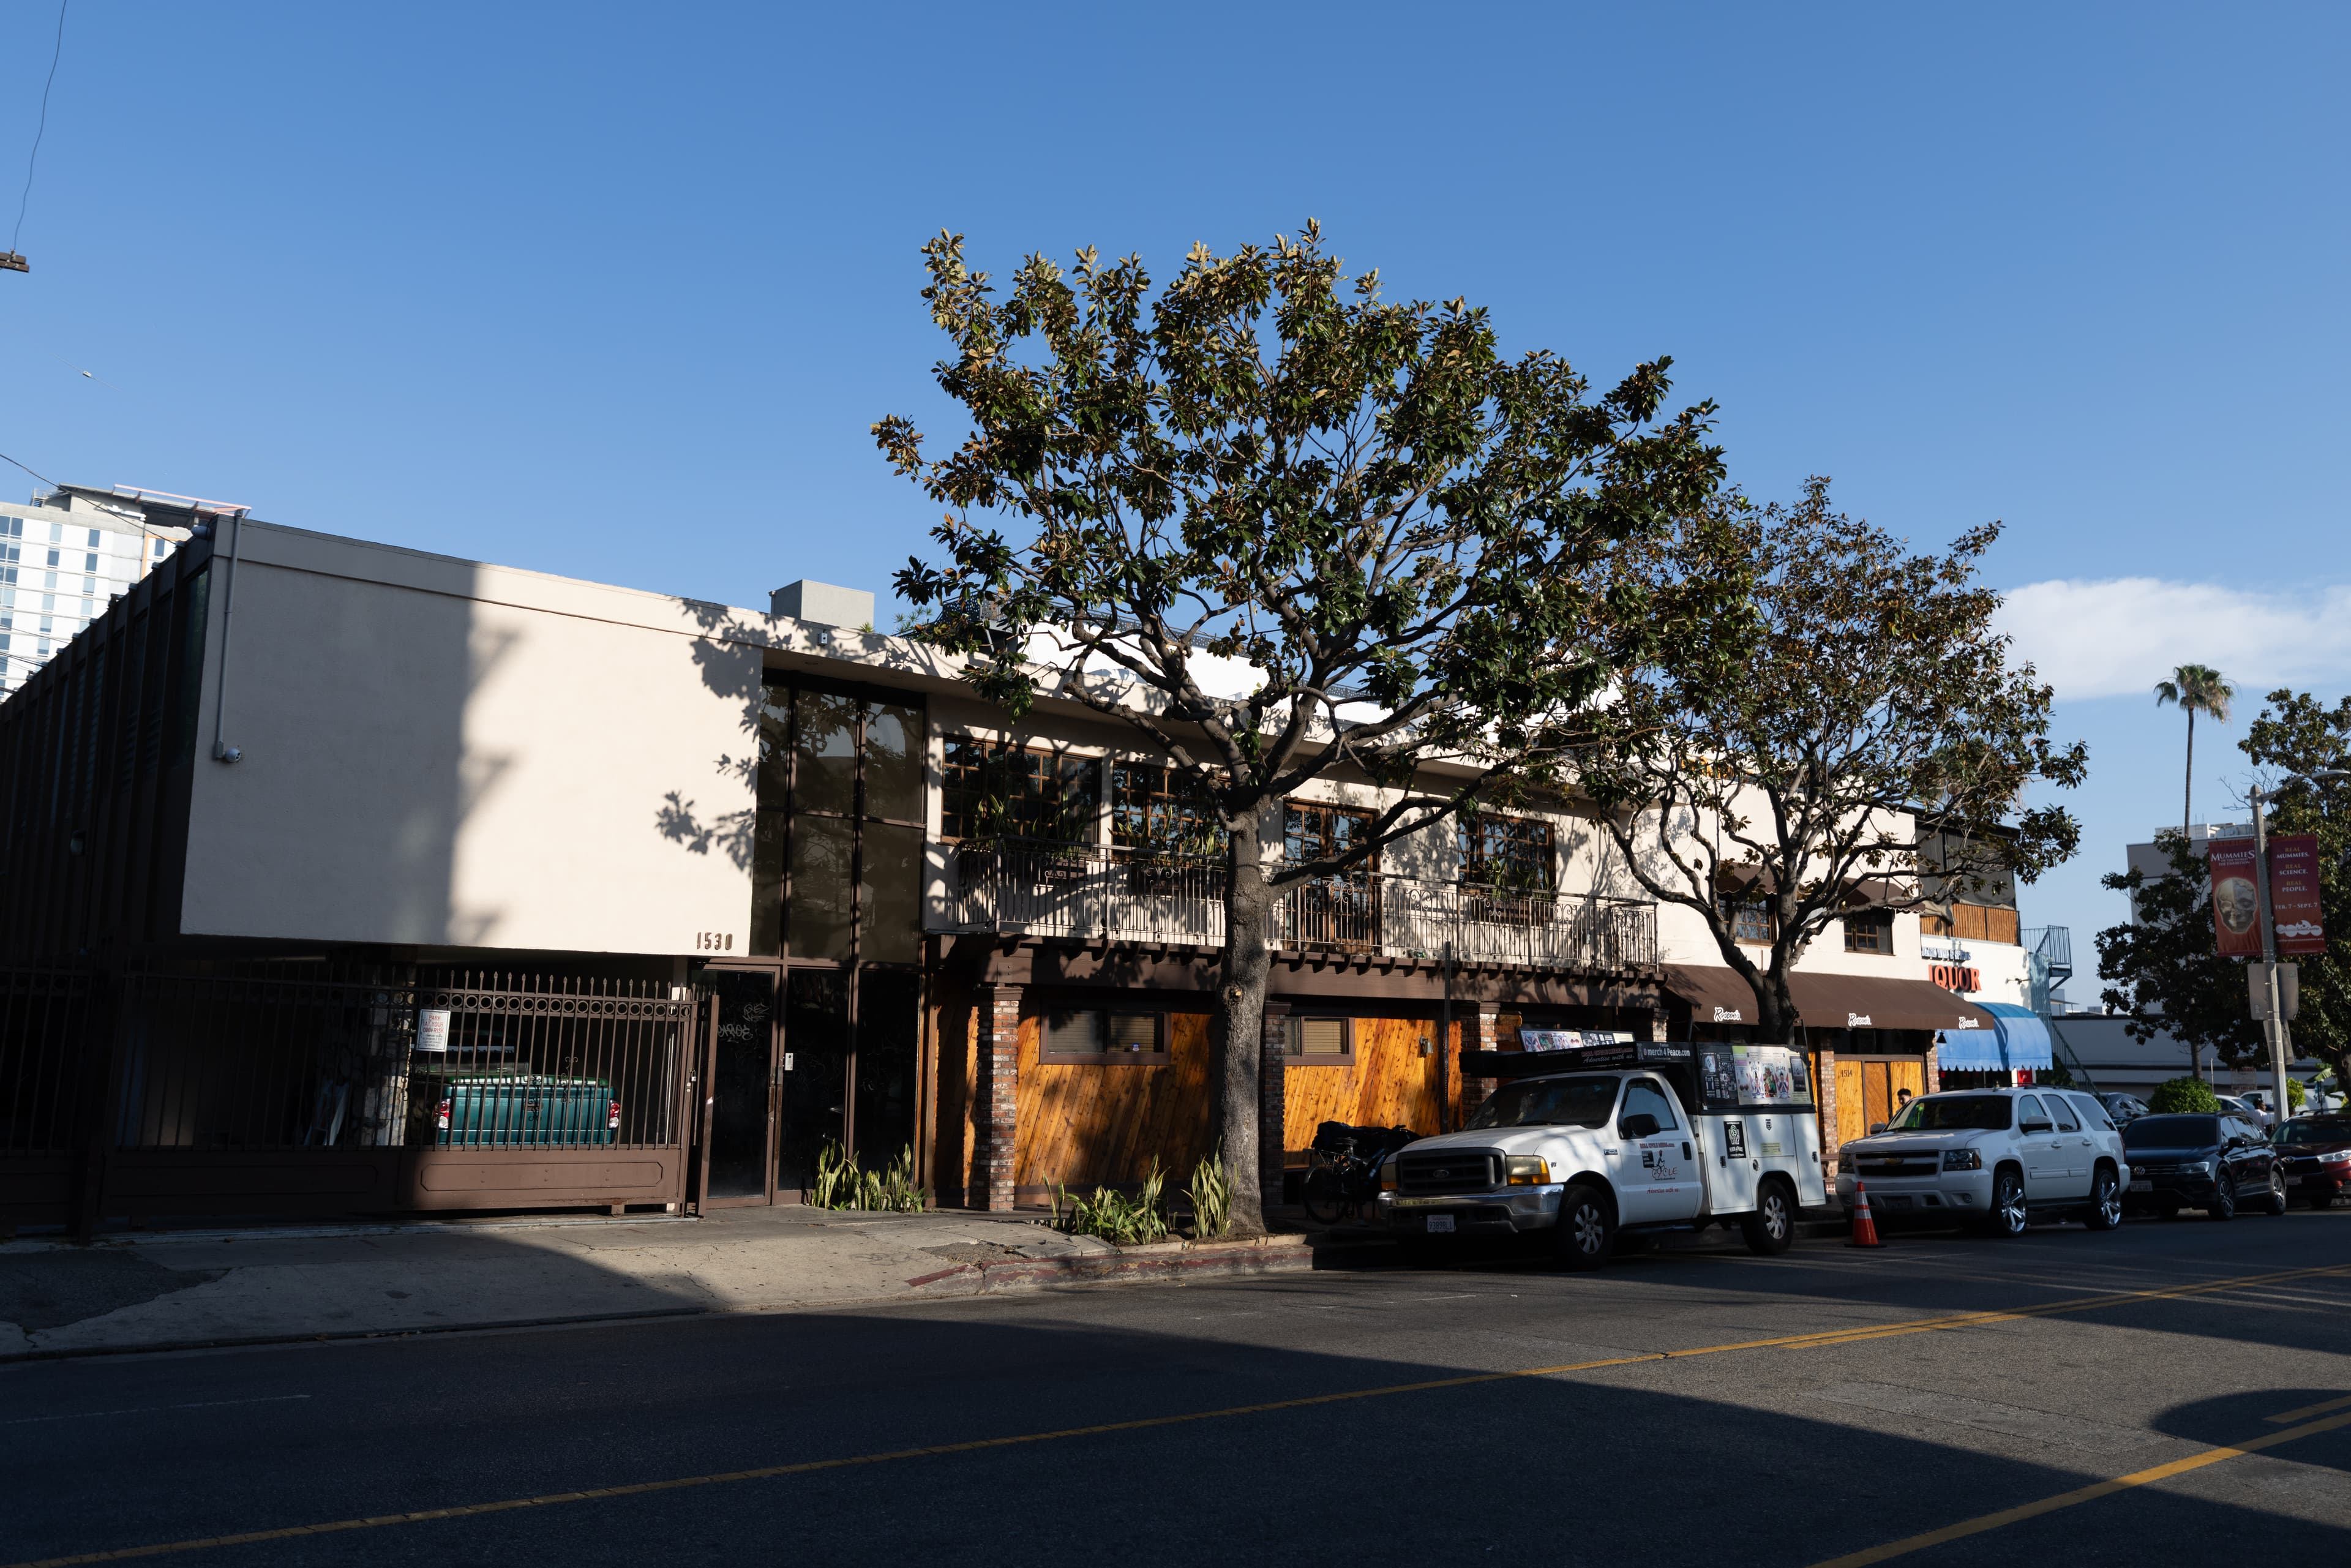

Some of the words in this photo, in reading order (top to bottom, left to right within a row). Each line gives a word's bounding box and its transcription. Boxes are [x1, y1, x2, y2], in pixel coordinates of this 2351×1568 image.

[2211, 850, 2255, 861] MUMMIES
[697, 932, 733, 950] 1530
[1928, 964, 1982, 991] IQUOR
[1647, 1047, 1663, 1056] merch
[1663, 1048, 1667, 1056] 4
[1667, 1048, 1690, 1057] Peace.com
